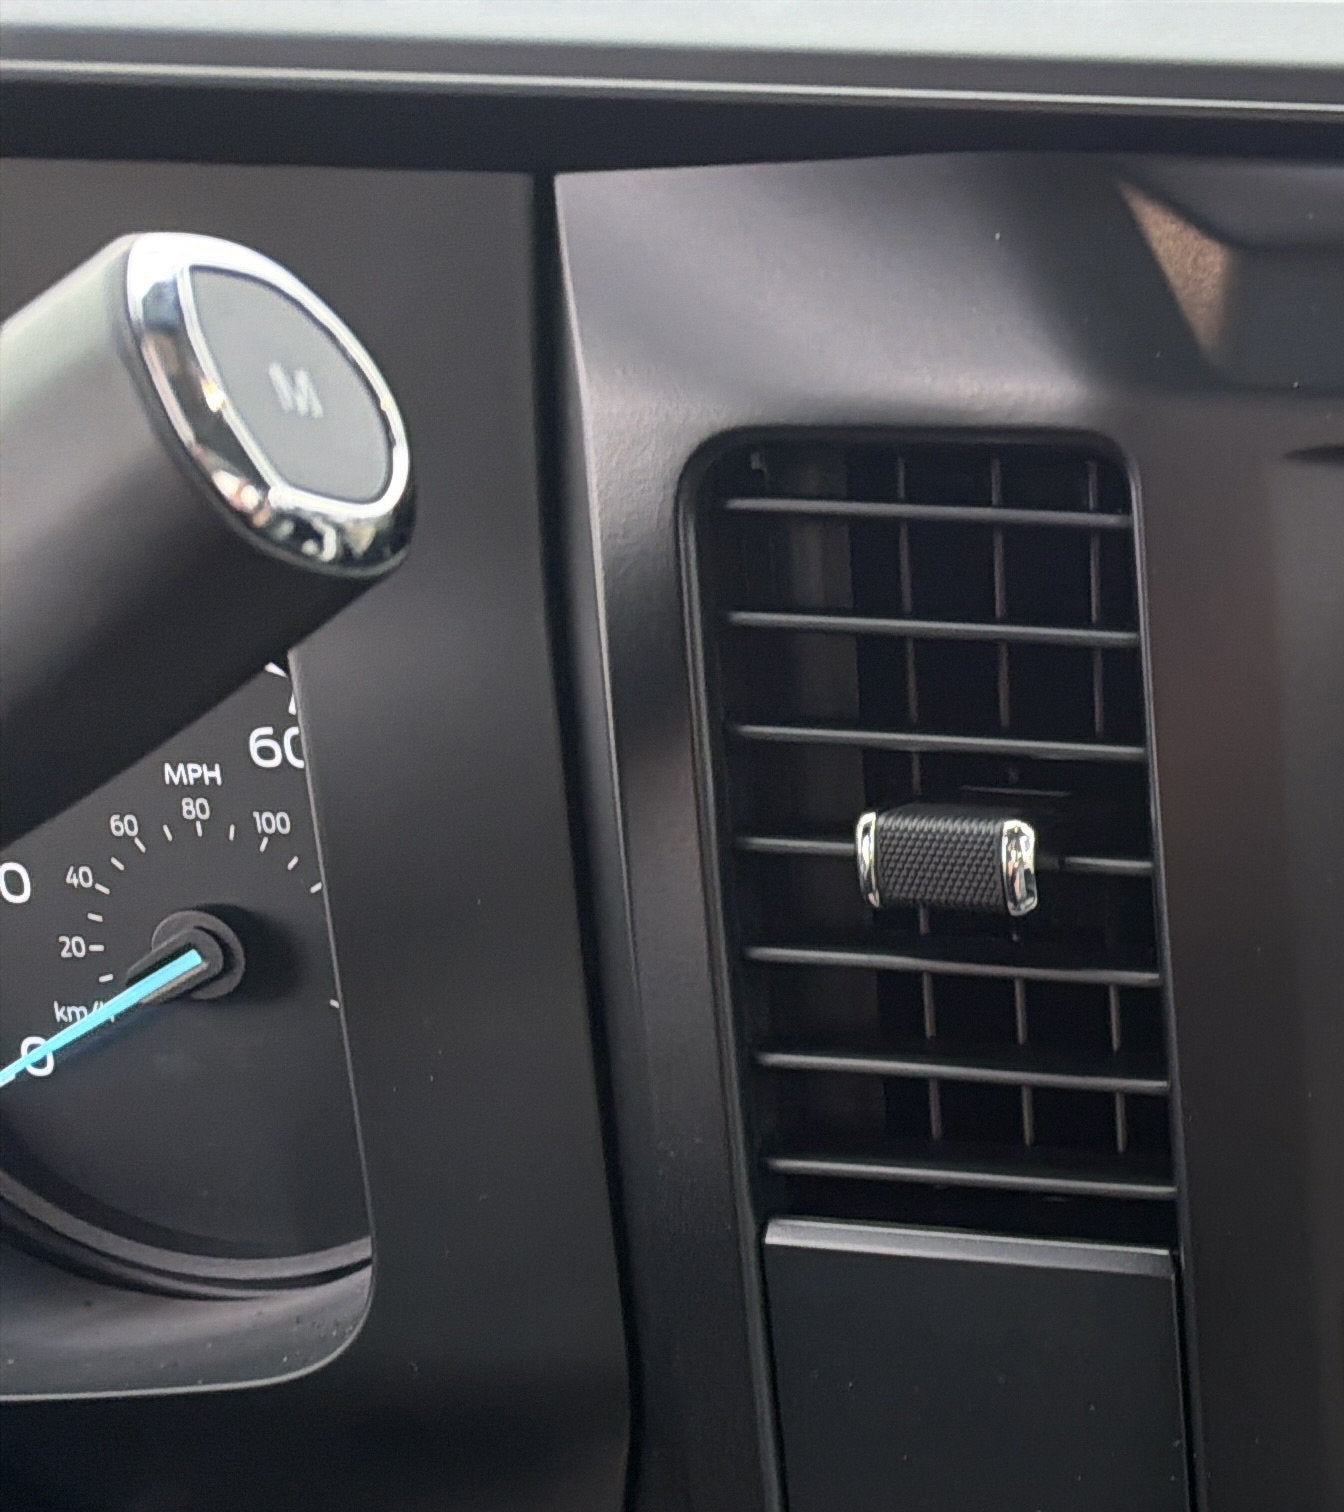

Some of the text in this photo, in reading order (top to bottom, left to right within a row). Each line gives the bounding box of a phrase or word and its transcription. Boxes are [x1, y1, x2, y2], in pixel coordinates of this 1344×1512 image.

[163, 762, 222, 787] MPH
[181, 797, 210, 820] 80
[110, 814, 139, 838] 60
[252, 810, 291, 835] 100
[65, 865, 93, 888] 40
[58, 935, 86, 958] 20
